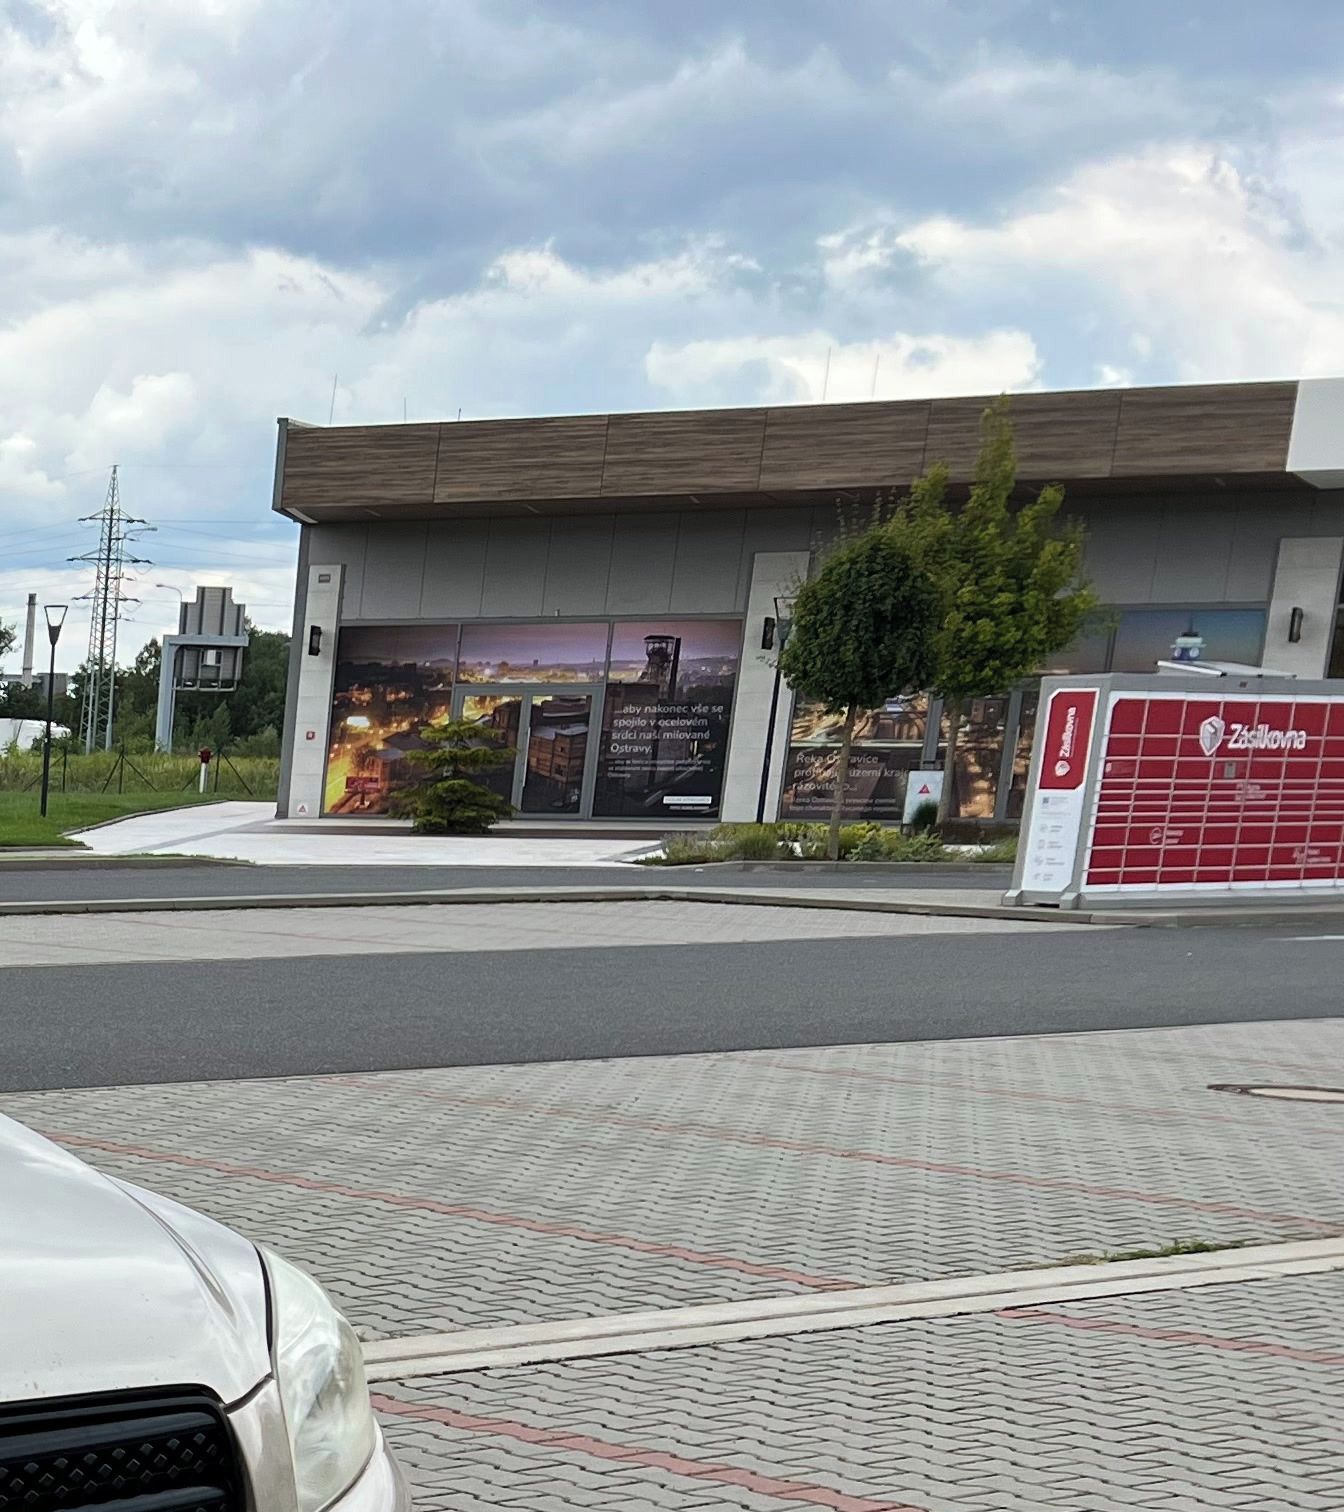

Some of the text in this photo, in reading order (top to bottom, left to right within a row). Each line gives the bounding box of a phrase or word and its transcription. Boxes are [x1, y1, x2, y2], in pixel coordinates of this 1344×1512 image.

[644, 704, 688, 713] nakonec
[691, 703, 709, 713] vše
[712, 705, 724, 713] se
[613, 717, 647, 728] spojilo
[658, 717, 708, 727] ocelovém
[662, 730, 710, 740] milované
[1227, 723, 1307, 750] Zásilkovna
